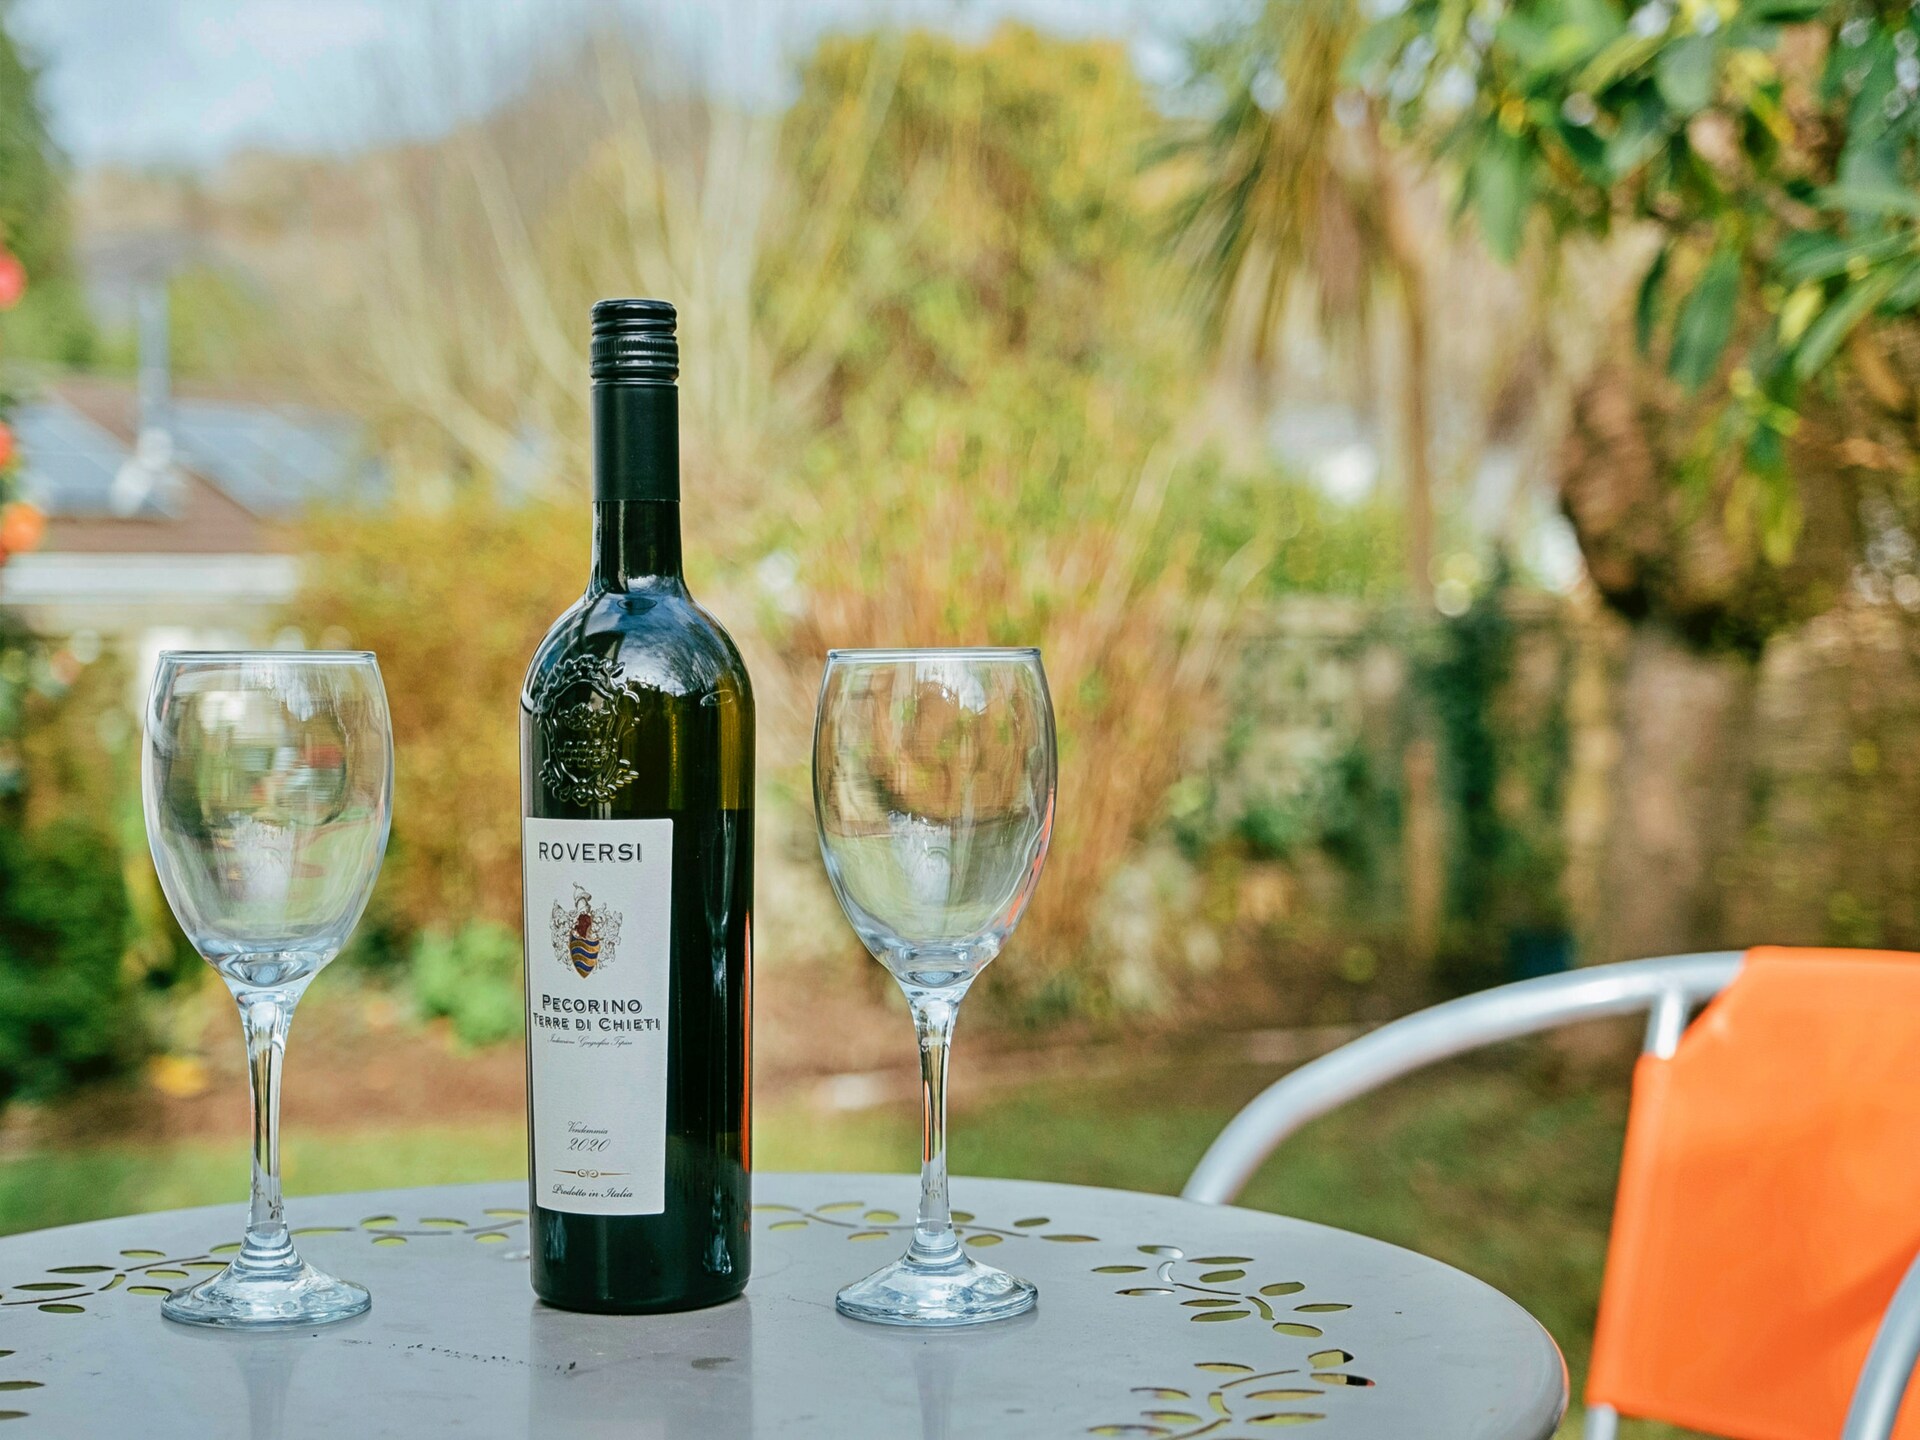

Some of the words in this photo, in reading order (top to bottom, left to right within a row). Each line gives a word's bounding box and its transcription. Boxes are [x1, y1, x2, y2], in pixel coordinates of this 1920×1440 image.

[539, 842, 642, 862] ROVERSI
[542, 994, 642, 1014] PECORINO
[533, 1012, 569, 1030] TERRE
[576, 1019, 591, 1031] DI
[599, 1018, 660, 1031] CHIETI
[567, 1137, 611, 1152] 2020
[552, 1184, 586, 1197] Prodotto
[588, 1189, 599, 1198] in
[601, 1187, 632, 1198] Italia
